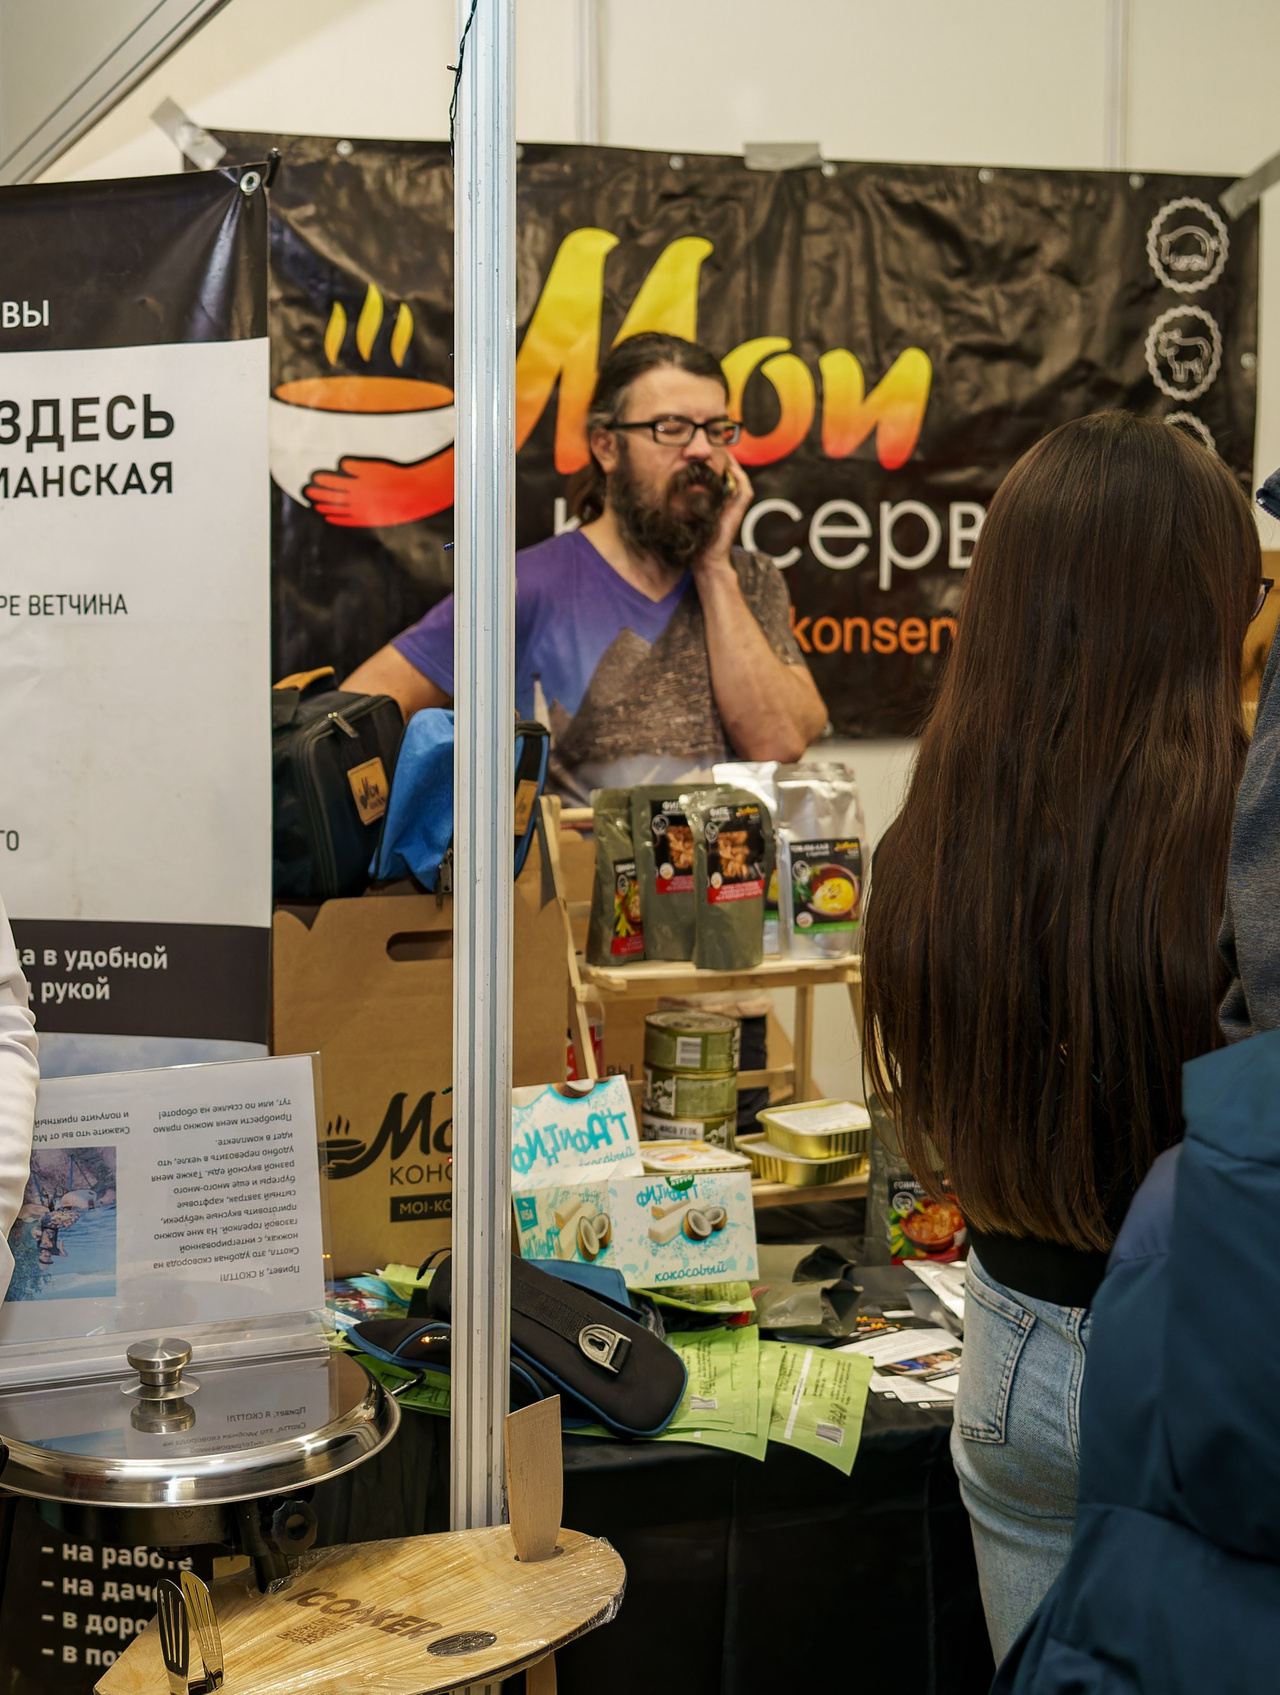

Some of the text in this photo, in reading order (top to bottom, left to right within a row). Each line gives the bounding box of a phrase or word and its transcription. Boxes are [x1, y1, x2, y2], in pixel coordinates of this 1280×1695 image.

[29, 592, 128, 617] ВЕТЧИНА
[16, 945, 168, 972] а в удобной
[41, 976, 110, 1004] рукой
[654, 1261, 728, 1283] кокосовый
[63, 1543, 93, 1562] на
[63, 1577, 93, 1596] на
[62, 1611, 77, 1629] в
[62, 1645, 77, 1663] в
